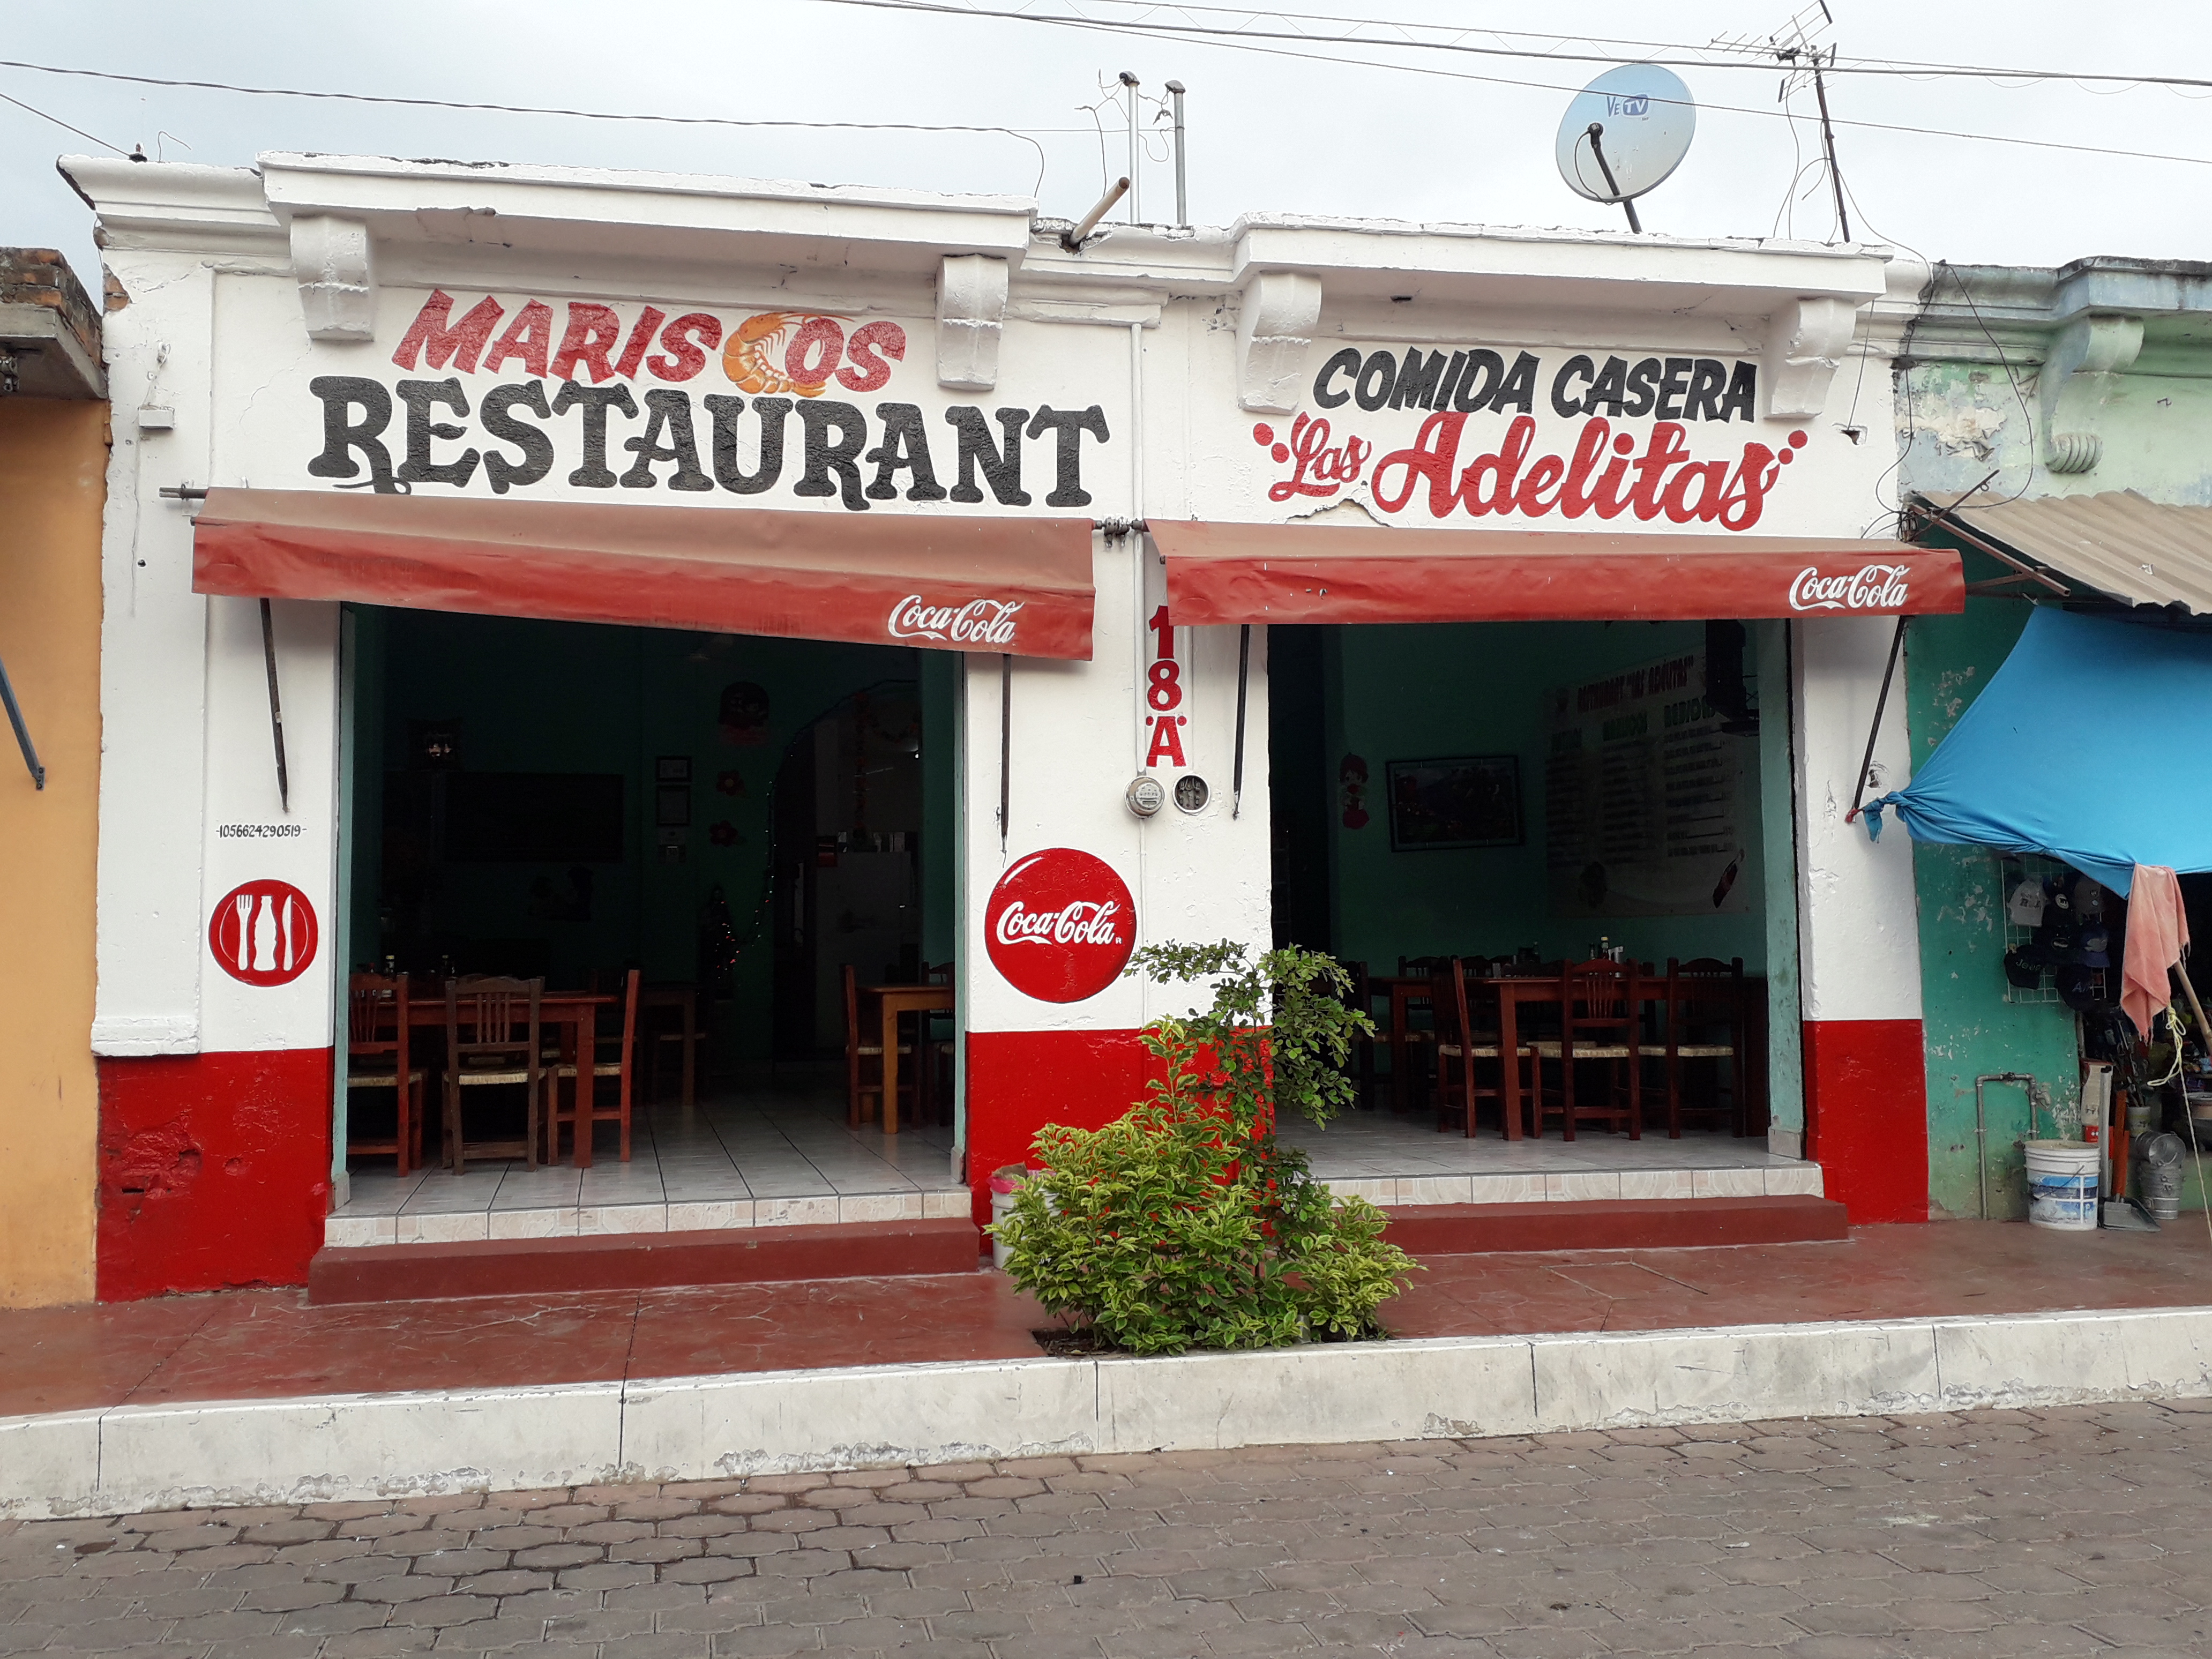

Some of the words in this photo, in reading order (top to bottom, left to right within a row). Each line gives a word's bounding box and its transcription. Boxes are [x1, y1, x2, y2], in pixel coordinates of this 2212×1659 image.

[1313, 346, 1539, 413] COMIDA
[1551, 354, 1757, 422] CASERA
[307, 376, 1110, 510] RESTAURANT
[1268, 411, 1371, 502] Las
[1371, 411, 1779, 532] Adelitas
[887, 594, 1025, 644] Coca-Cola
[1789, 565, 1910, 610] Coca-Cola
[997, 901, 1120, 945] Coca-Cola
